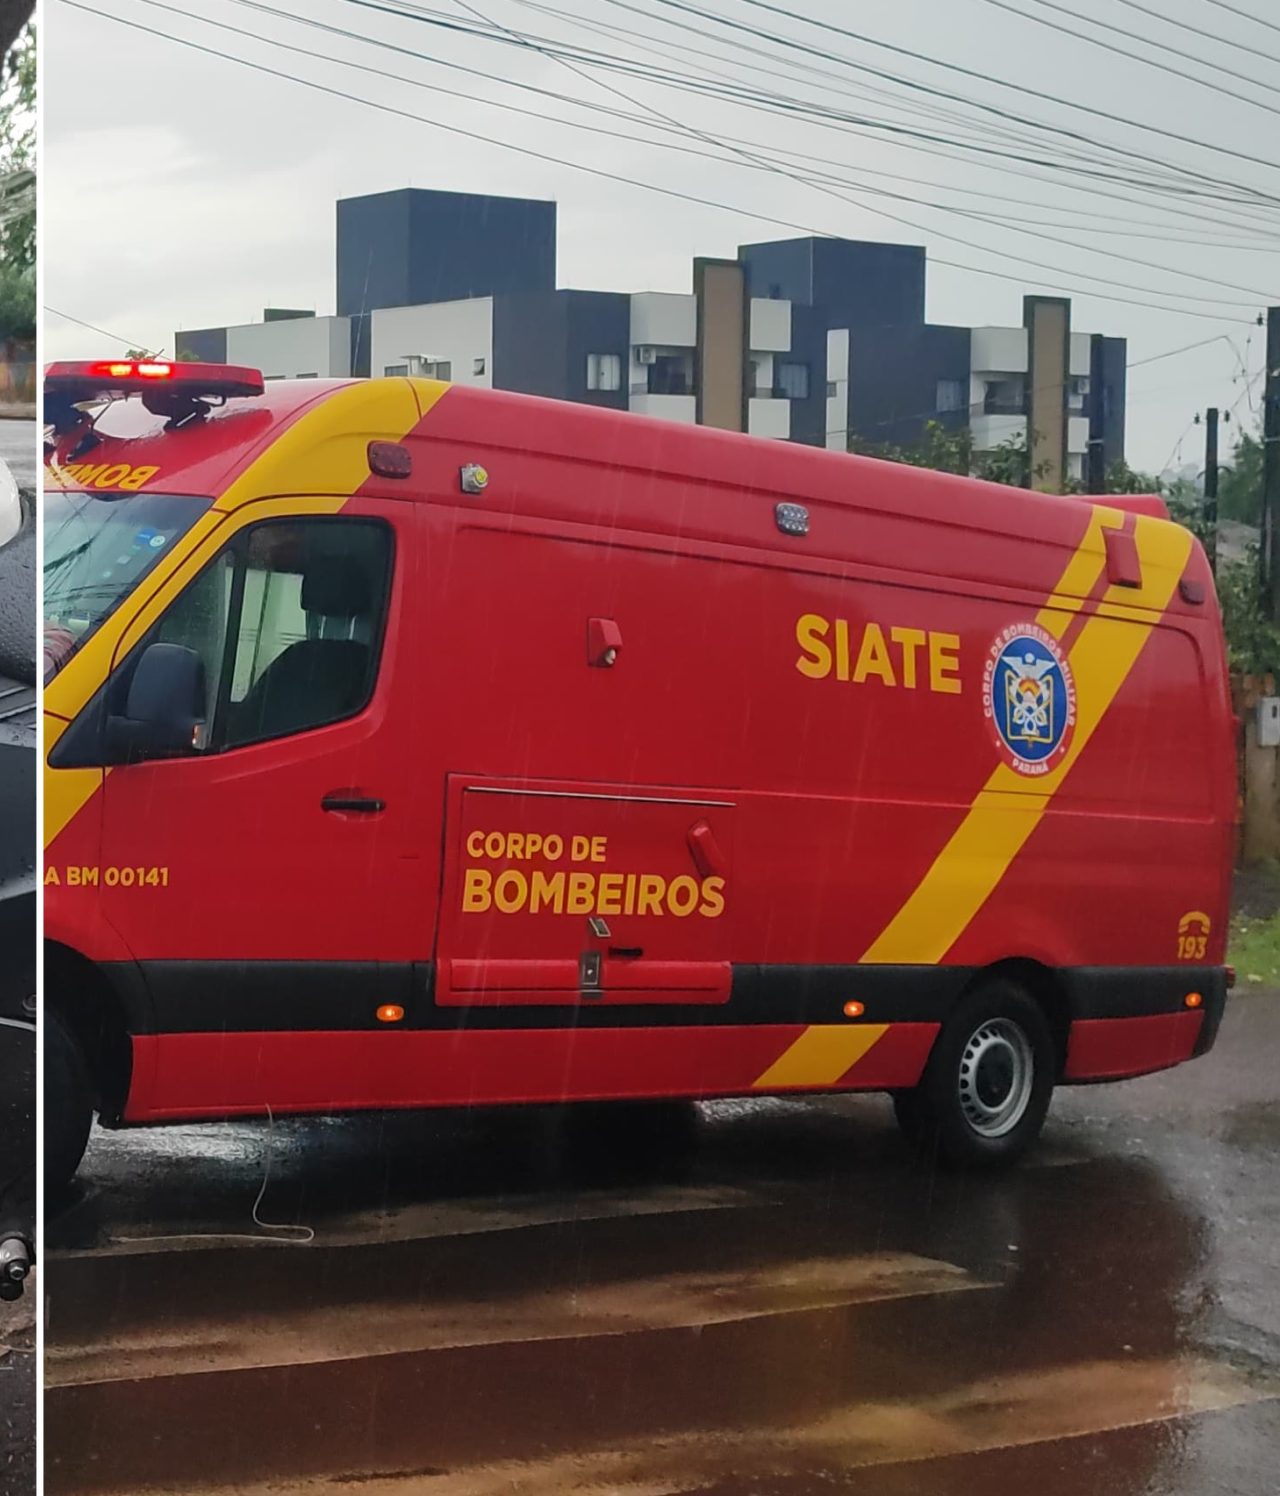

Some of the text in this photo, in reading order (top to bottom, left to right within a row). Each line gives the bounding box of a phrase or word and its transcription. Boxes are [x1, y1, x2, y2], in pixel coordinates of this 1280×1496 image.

[795, 613, 962, 694] SIATE
[982, 623, 1076, 726] CORPO DE BOMBEIROS MILITAR
[466, 830, 608, 862] CORPO DE
[43, 866, 169, 887] A BM 00141
[462, 868, 726, 918] BOMBEIROS
[1177, 935, 1207, 959] 193
